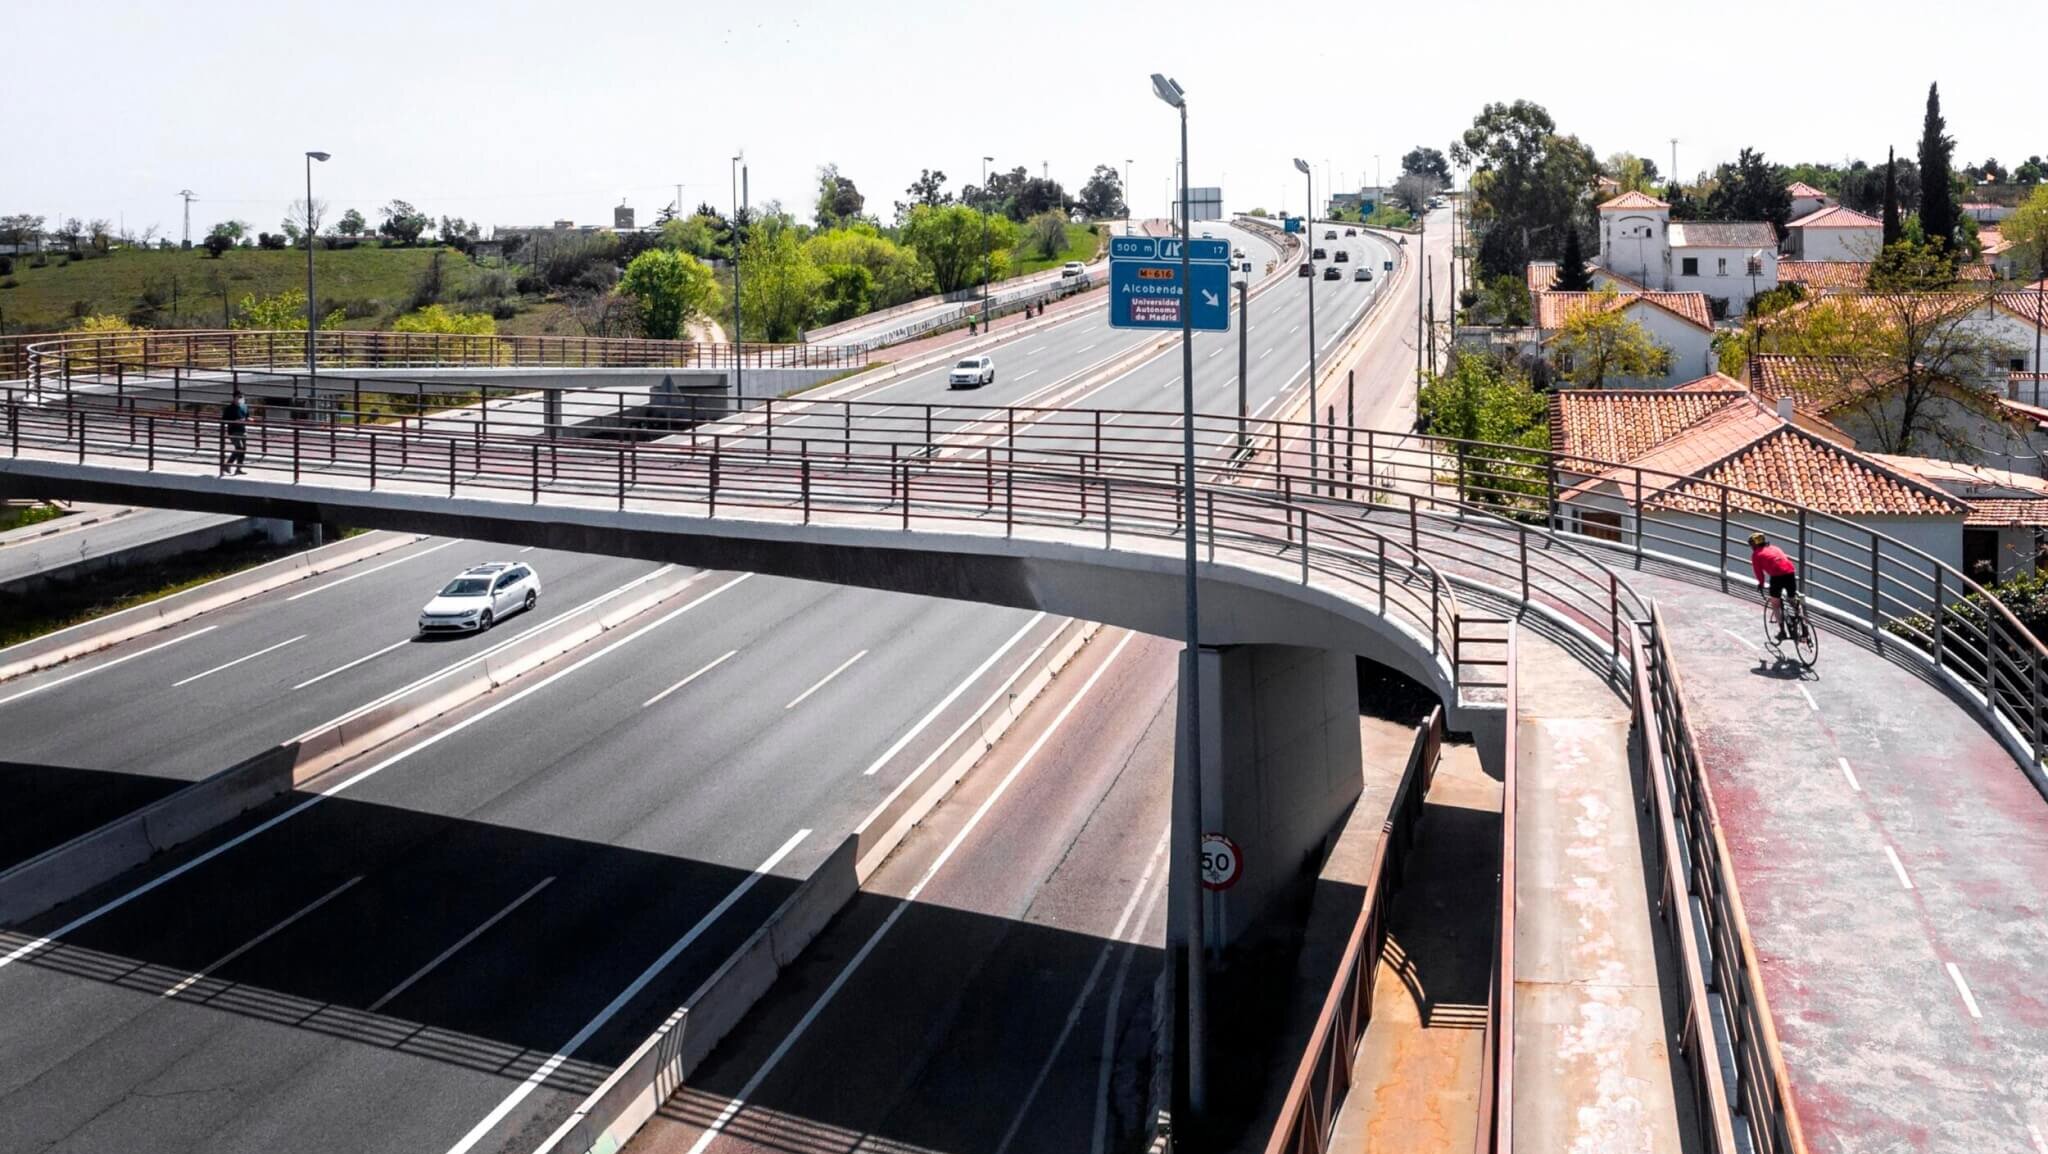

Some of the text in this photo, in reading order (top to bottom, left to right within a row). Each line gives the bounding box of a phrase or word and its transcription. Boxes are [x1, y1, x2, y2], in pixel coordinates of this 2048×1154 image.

[1117, 243, 1137, 252] 500
[1213, 246, 1224, 254] 17
[1140, 269, 1172, 278] M-616
[1122, 284, 1185, 295] Alcobenda
[1131, 298, 1180, 306] Universidad
[1135, 305, 1176, 313] Autónoma
[1135, 313, 1177, 321] de Madrid
[1201, 852, 1229, 871] 50
